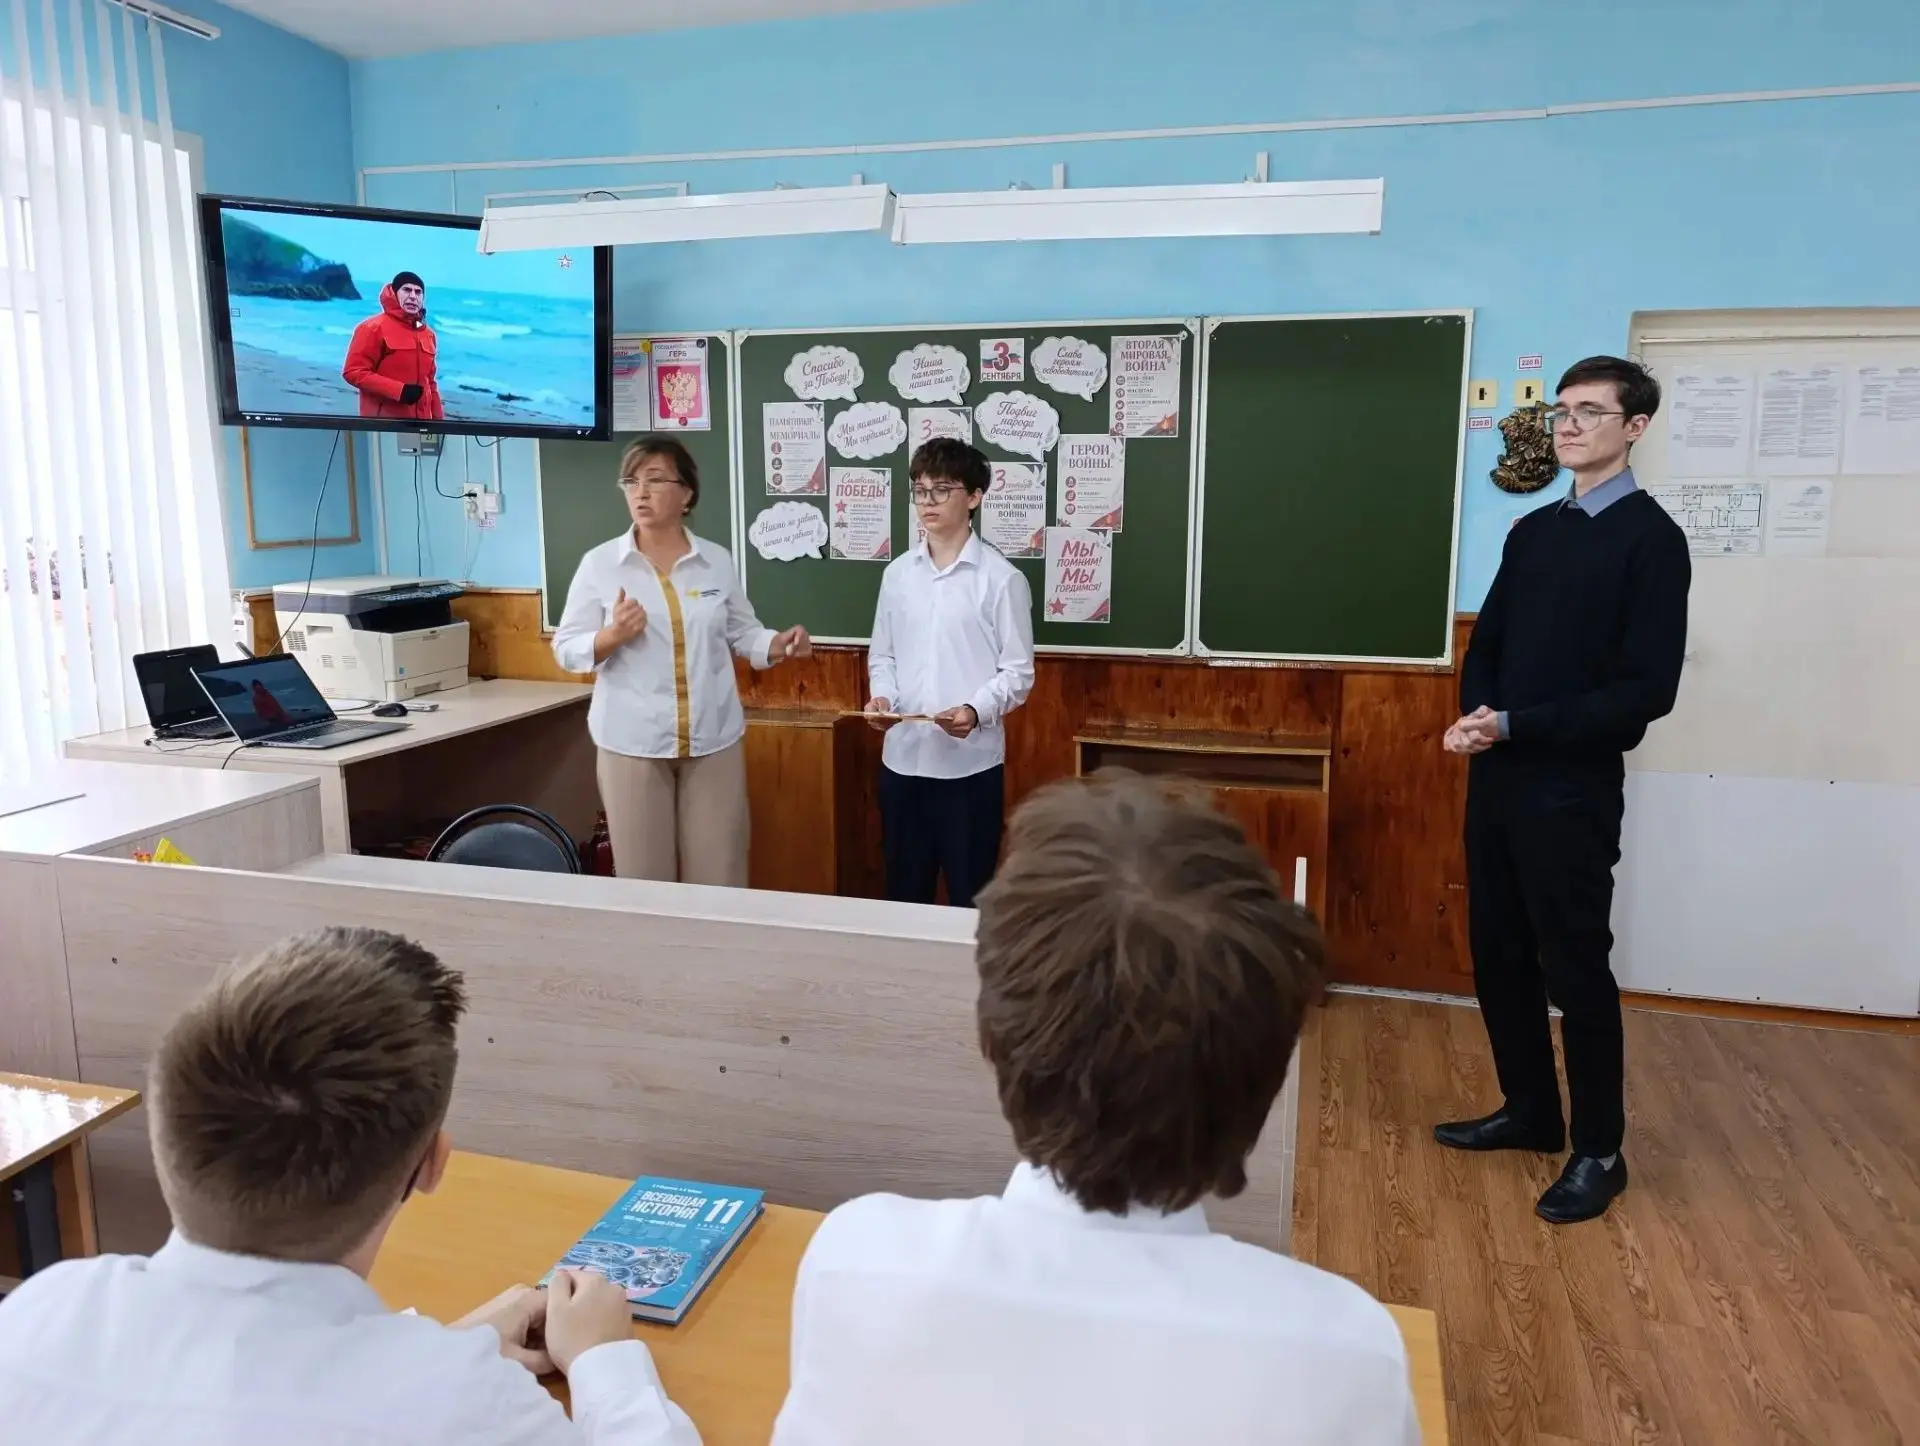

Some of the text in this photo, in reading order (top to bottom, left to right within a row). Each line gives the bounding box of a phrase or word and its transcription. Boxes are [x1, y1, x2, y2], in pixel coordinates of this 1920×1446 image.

[1056, 346, 1082, 359] Слава
[1126, 340, 1165, 350] ВТОРАЯ
[668, 350, 687, 358] ГЕРБ
[993, 341, 1010, 372] 3
[1121, 350, 1168, 361] МИРОВАЯ
[802, 355, 847, 377] Спасибо
[912, 356, 944, 371] Наша
[1125, 360, 1166, 372] ВОЙНА
[803, 369, 851, 392] за Победу!
[908, 375, 954, 390] наша сила
[981, 371, 1022, 381] СЕНТЯБРЯ
[997, 401, 1038, 418] Подвиг
[837, 411, 892, 438] Мы помним!
[920, 419, 933, 440] 3
[1000, 417, 1035, 428] народа
[769, 431, 821, 441] МЕМОРИАЛЫ
[843, 424, 894, 449] Мы гордимся!
[990, 425, 1044, 440] бессмертен
[1070, 444, 1111, 456] ГЕРОИ
[991, 469, 1006, 491] 3
[836, 485, 886, 499] ПОБЕДЫ
[759, 520, 786, 535] Никто
[787, 519, 796, 528] не
[783, 535, 791, 543] не
[1061, 539, 1096, 558] МЫ
[1056, 556, 1103, 568] ПОМНИМ!
[1060, 568, 1096, 584] МЫ
[1055, 582, 1103, 593] ГОРДИМСЯ!
[640, 1191, 708, 1208] ВСЕОБЩАЯ
[631, 1200, 700, 1220] ИСТОРИЯ
[704, 1198, 745, 1225] 11
